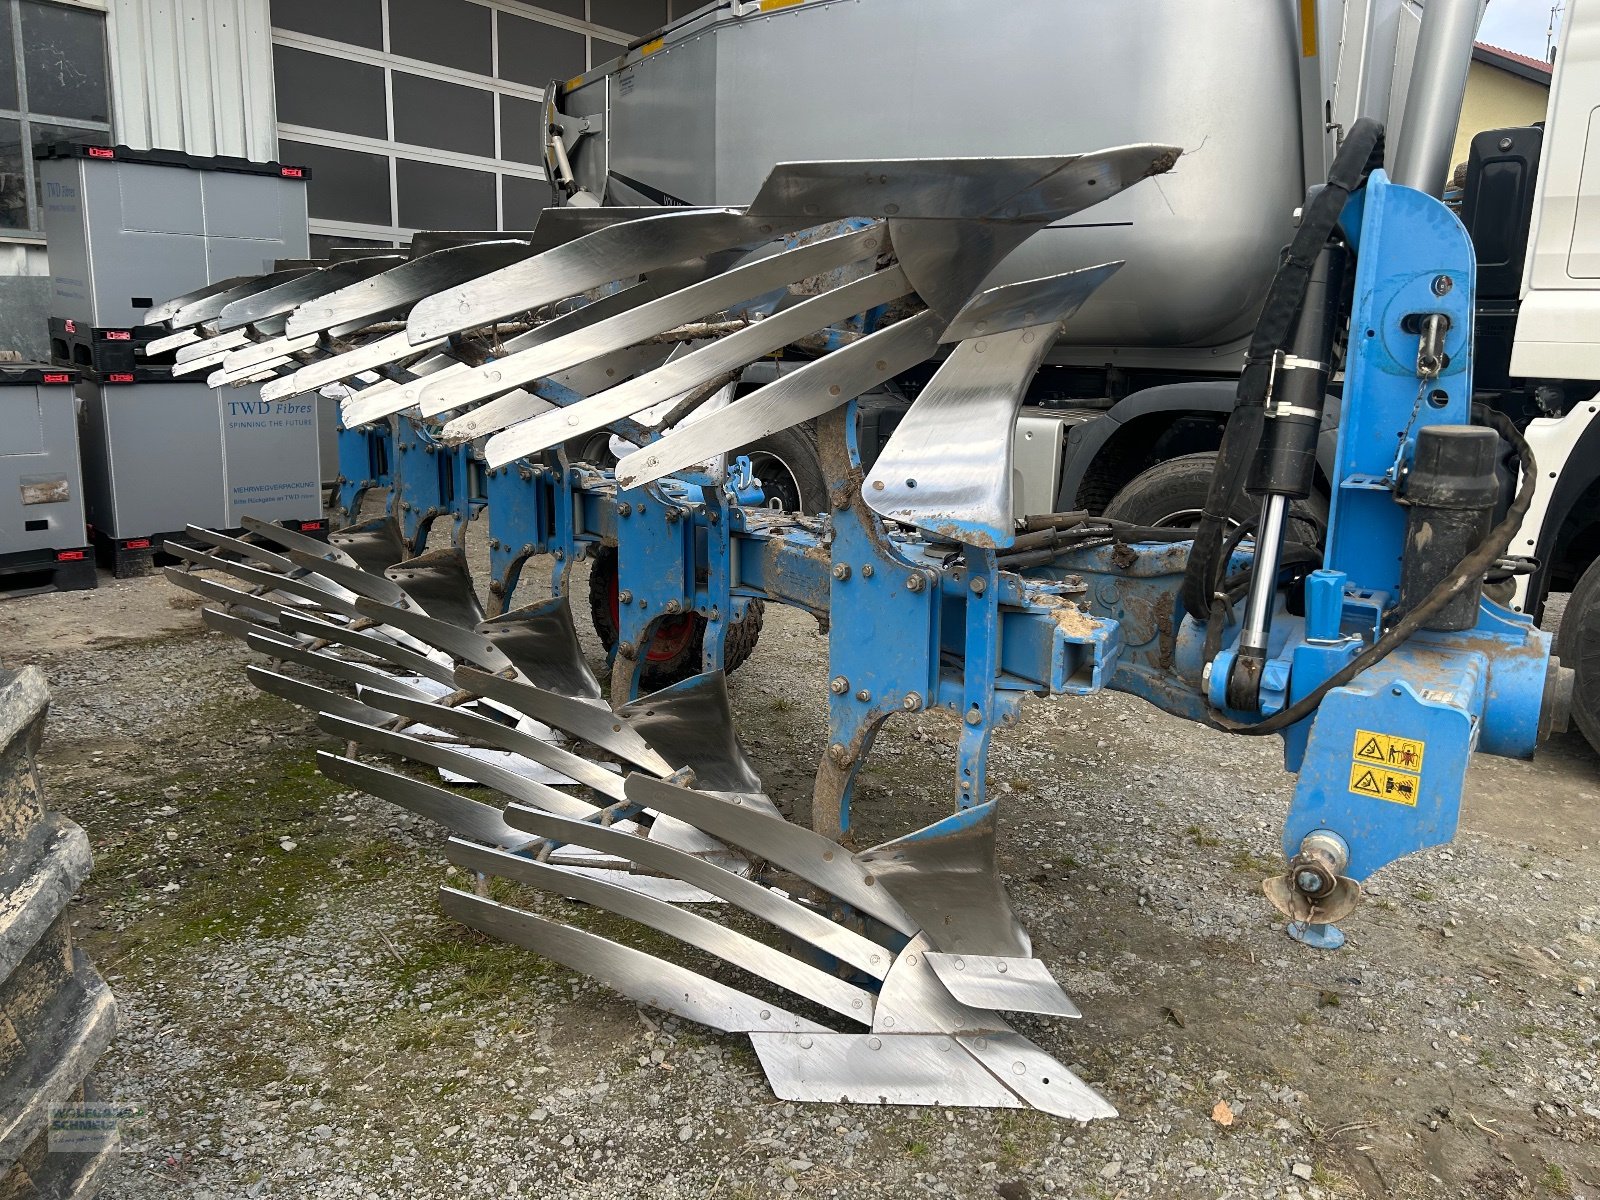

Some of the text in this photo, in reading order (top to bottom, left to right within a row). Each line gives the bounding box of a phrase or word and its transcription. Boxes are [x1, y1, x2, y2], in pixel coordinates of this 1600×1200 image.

[228, 401, 312, 416] TWD Fibres
[229, 421, 267, 429] SPINNING
[233, 481, 315, 494] MEHRWEGVERPACKUNG
[284, 493, 300, 501] TWD
